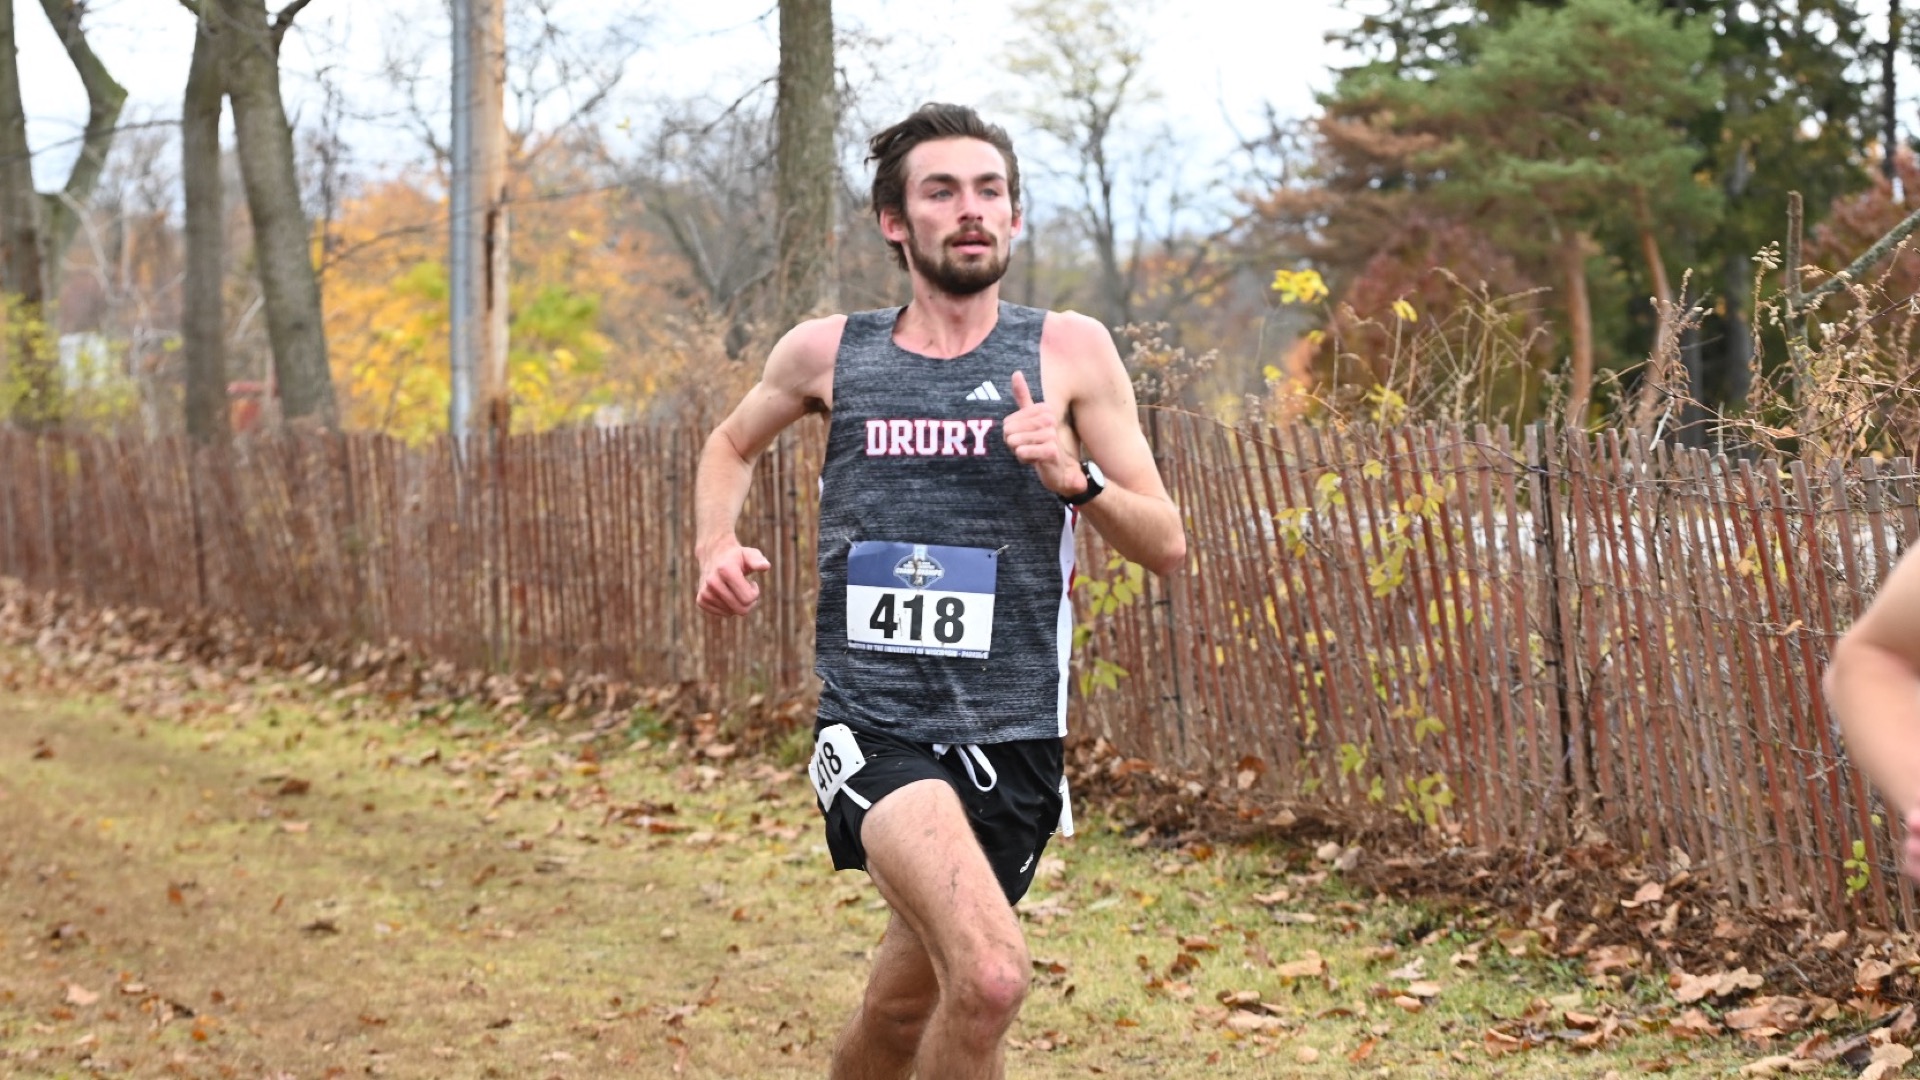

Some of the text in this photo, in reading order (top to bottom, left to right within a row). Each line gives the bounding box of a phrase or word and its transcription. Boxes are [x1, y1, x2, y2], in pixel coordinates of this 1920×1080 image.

[865, 418, 993, 456] DRURY
[869, 593, 965, 644] 418
[816, 741, 842, 792] 418
